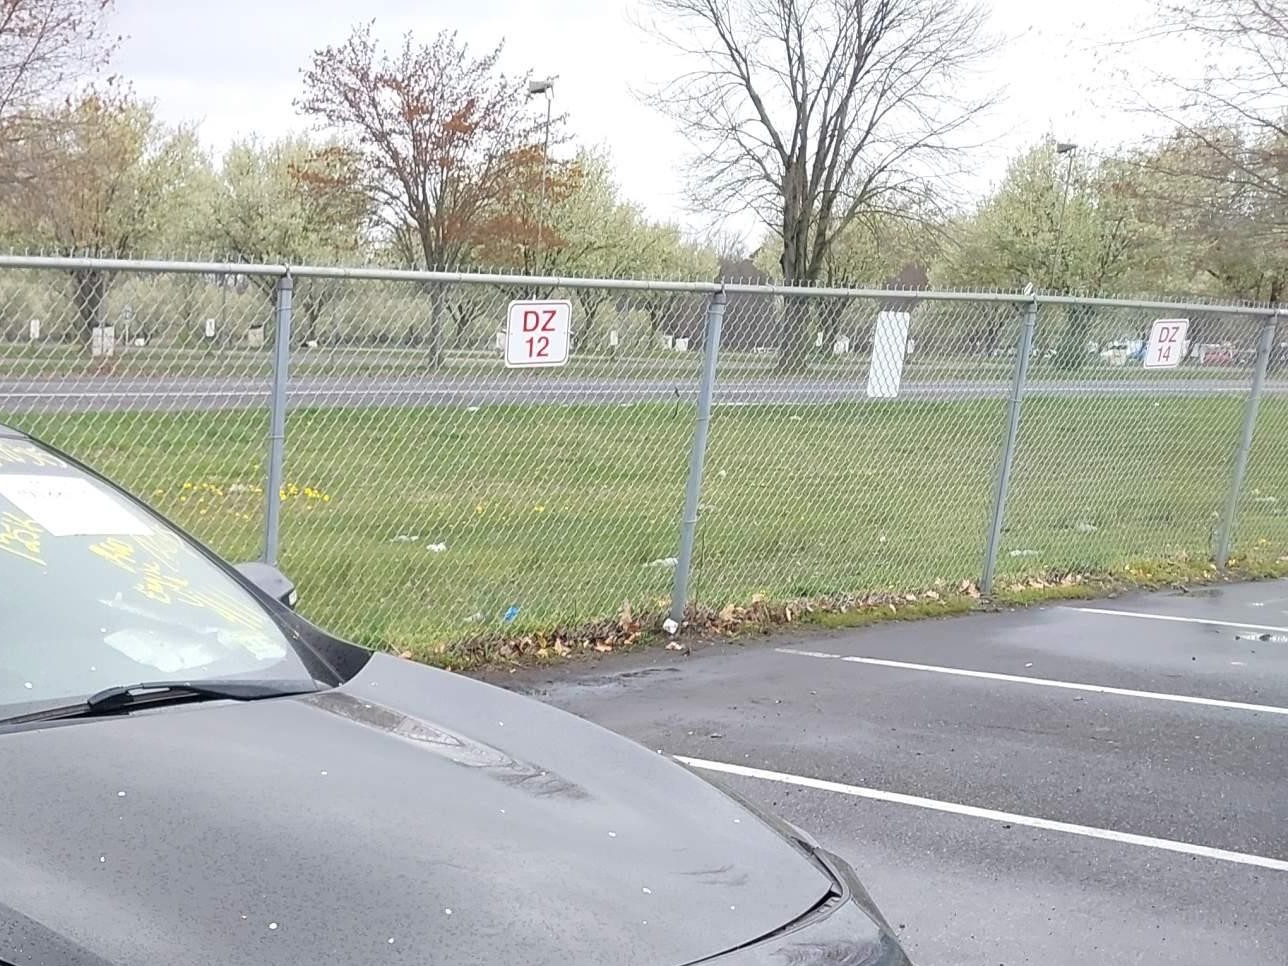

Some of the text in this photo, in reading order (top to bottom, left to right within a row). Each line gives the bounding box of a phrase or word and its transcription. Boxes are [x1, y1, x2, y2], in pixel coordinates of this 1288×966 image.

[522, 310, 557, 332] DZ
[1158, 326, 1180, 343] DZ
[525, 336, 550, 358] 12
[1157, 345, 1172, 362] 14
